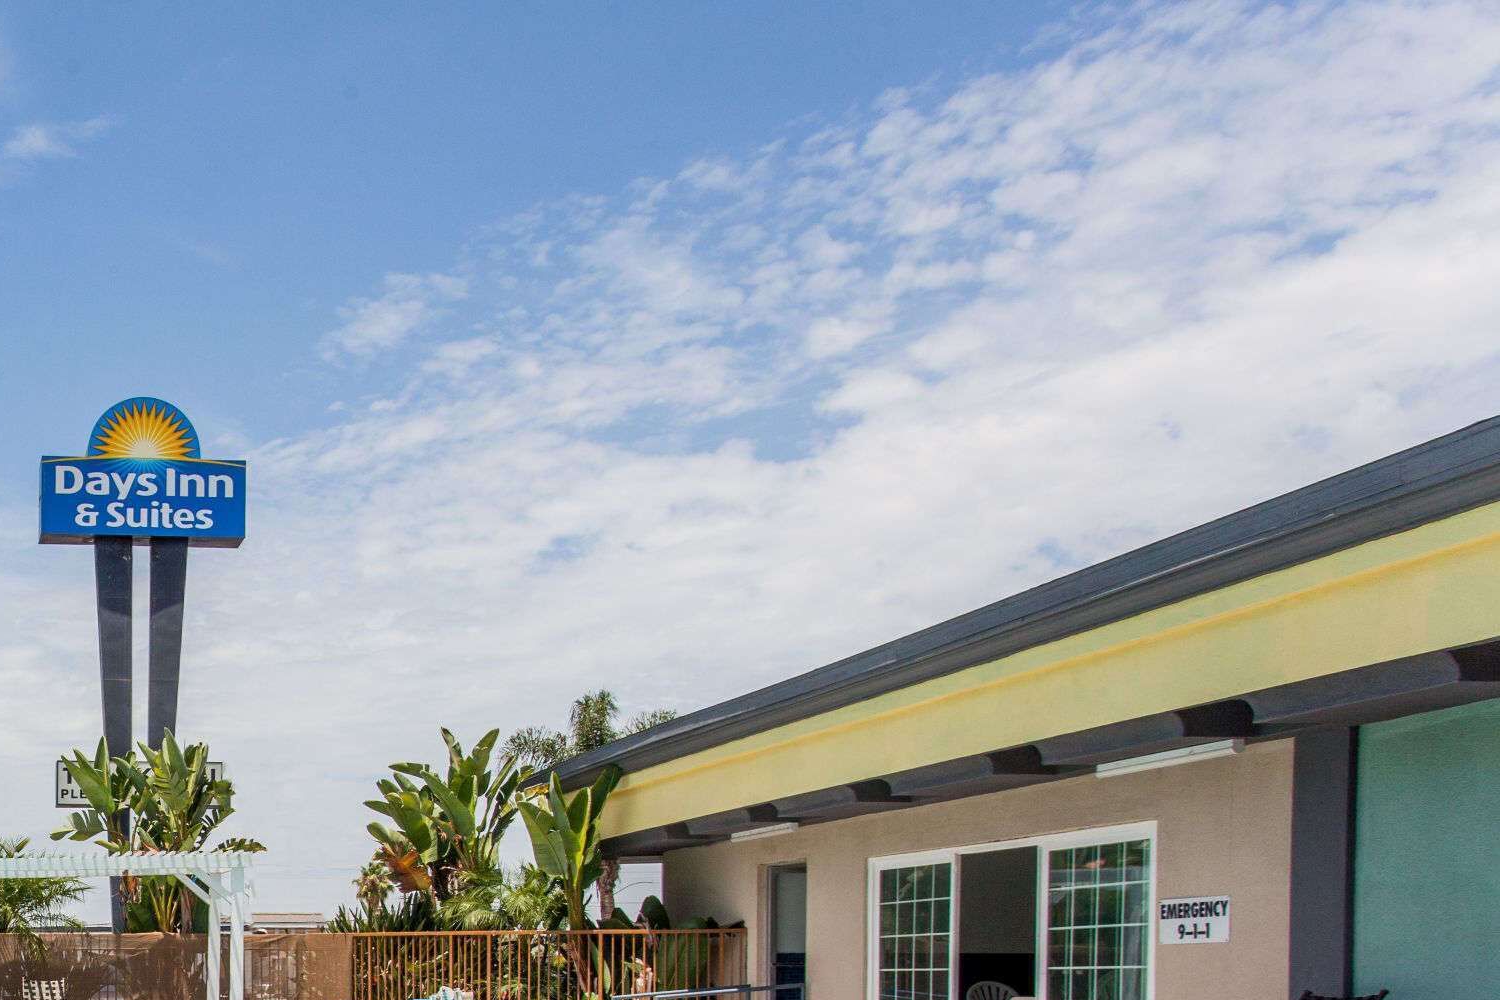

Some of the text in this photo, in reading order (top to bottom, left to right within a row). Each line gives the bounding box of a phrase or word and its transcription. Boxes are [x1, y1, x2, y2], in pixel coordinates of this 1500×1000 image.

[55, 465, 234, 500] Days Inn
[74, 501, 214, 530] & Suites
[1160, 900, 1229, 920] EMERGENCY
[1178, 922, 1211, 940] 9-1-1
